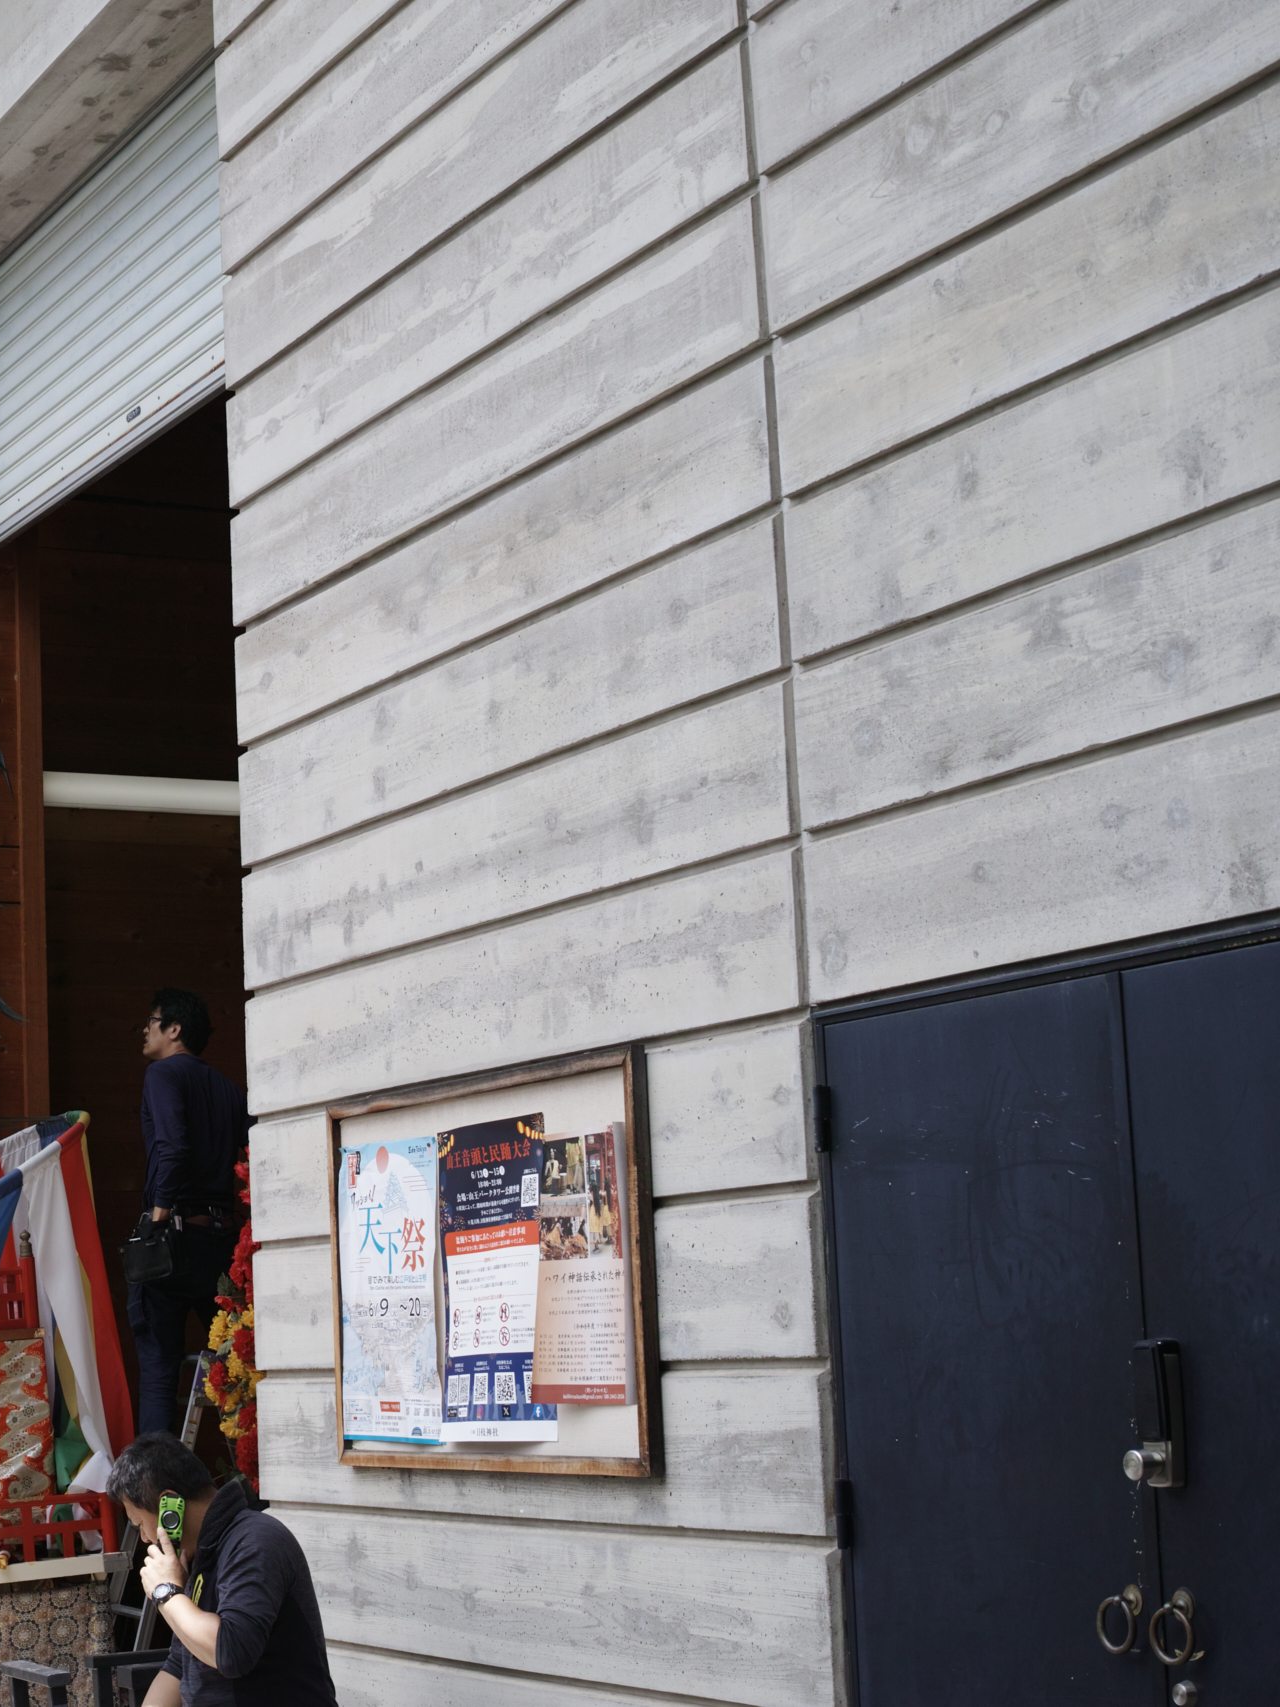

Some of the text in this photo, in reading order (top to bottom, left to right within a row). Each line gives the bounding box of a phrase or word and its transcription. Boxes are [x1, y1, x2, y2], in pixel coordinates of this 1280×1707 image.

[446, 1138, 531, 1170] 山王音頭と民踊大会
[358, 1203, 426, 1275] 天下祭
